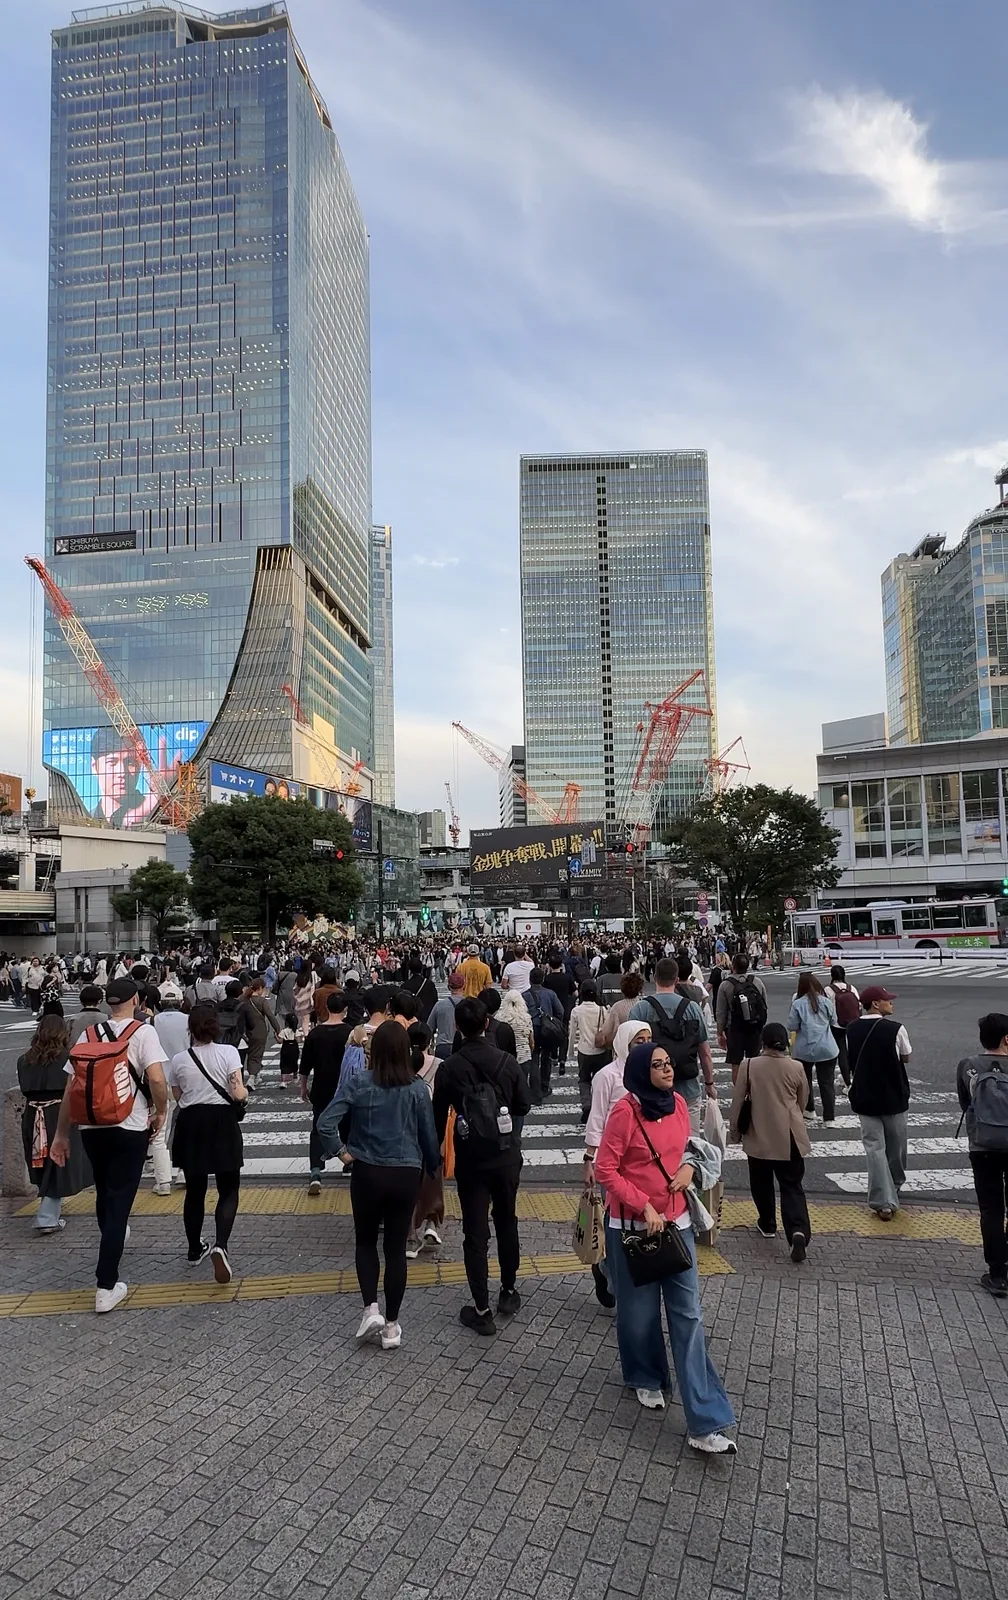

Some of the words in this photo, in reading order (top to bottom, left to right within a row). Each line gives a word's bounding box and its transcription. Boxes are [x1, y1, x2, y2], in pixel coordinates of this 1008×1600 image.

[70, 537, 99, 545] SHIBUYA
[70, 543, 105, 552] SCRAMBLE
[106, 540, 134, 549] SQUARE
[52, 734, 92, 744] 夢を叶える
[175, 727, 199, 742] dip
[229, 774, 255, 788] オトク
